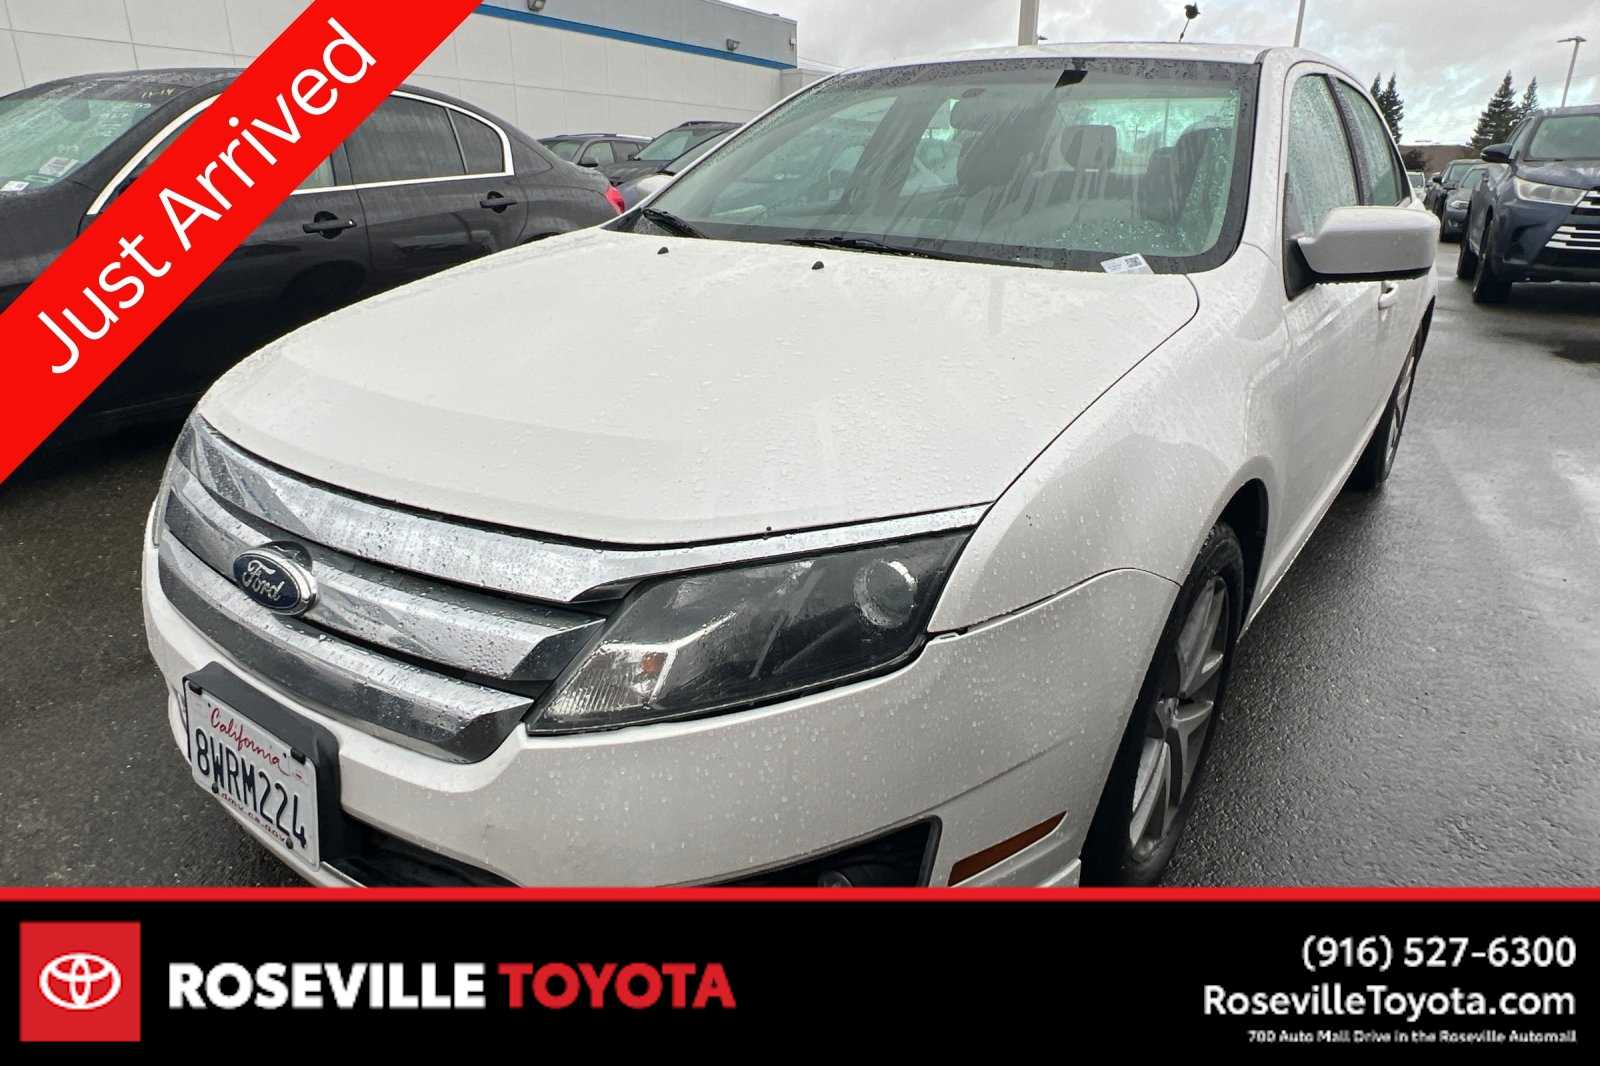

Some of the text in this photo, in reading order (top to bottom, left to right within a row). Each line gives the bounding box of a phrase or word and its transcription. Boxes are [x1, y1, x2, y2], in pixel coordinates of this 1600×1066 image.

[242, 560, 285, 601] Ford
[210, 708, 290, 778] California
[196, 729, 307, 849] 8WRM224
